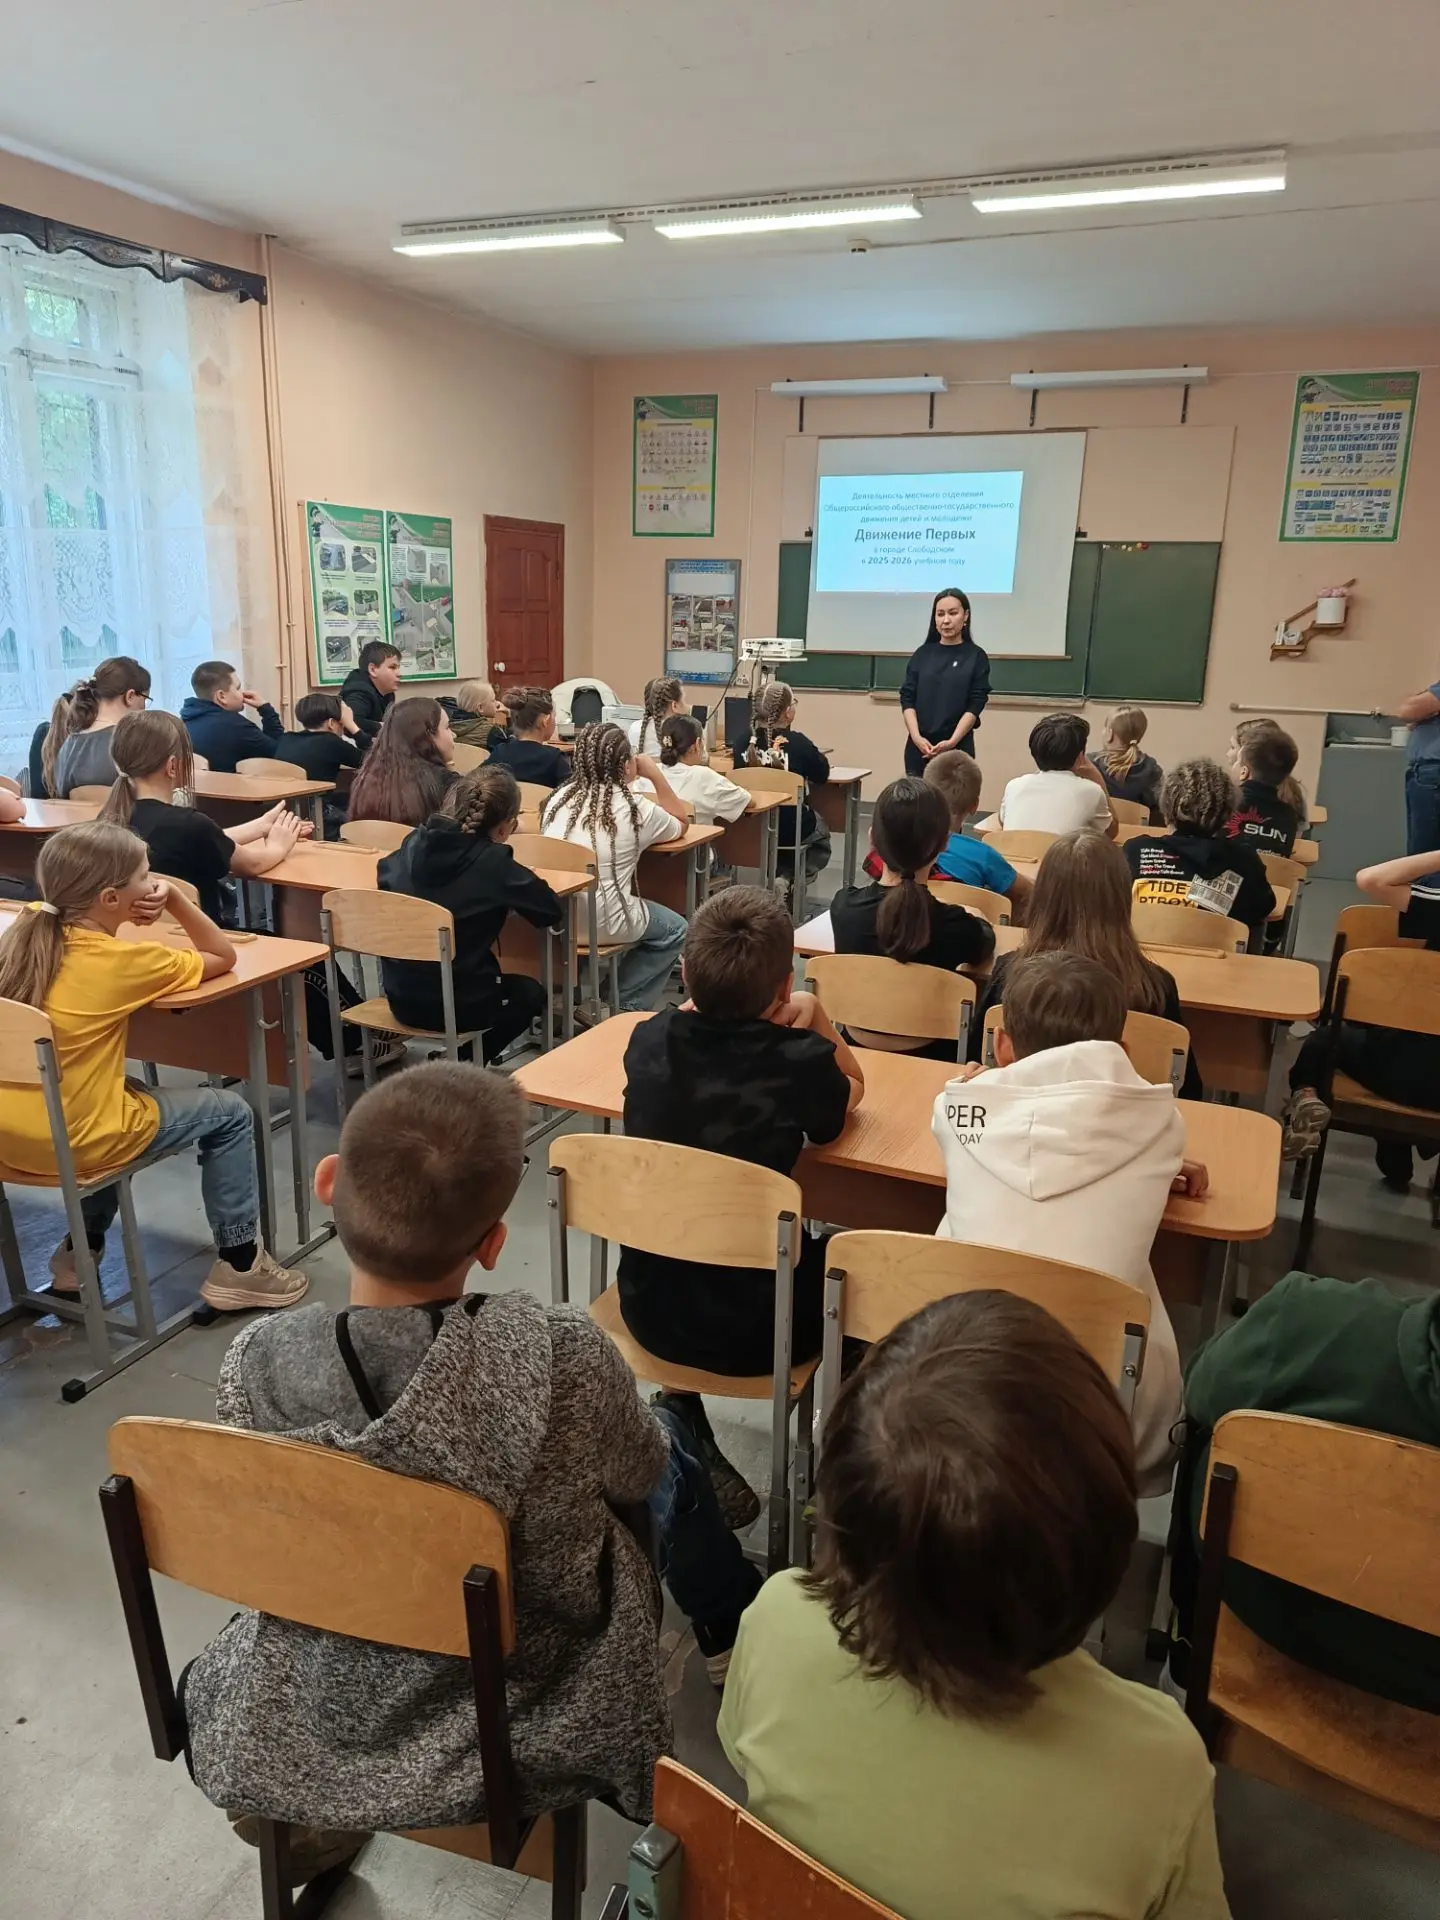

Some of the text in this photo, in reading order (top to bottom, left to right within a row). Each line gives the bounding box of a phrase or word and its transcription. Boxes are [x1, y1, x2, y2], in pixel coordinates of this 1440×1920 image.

[854, 528, 976, 543] Движение Первых
[1243, 823, 1288, 843] SUN
[1148, 880, 1188, 895] TIDE
[945, 1105, 987, 1128] PER
[956, 1133, 983, 1146] DAY
